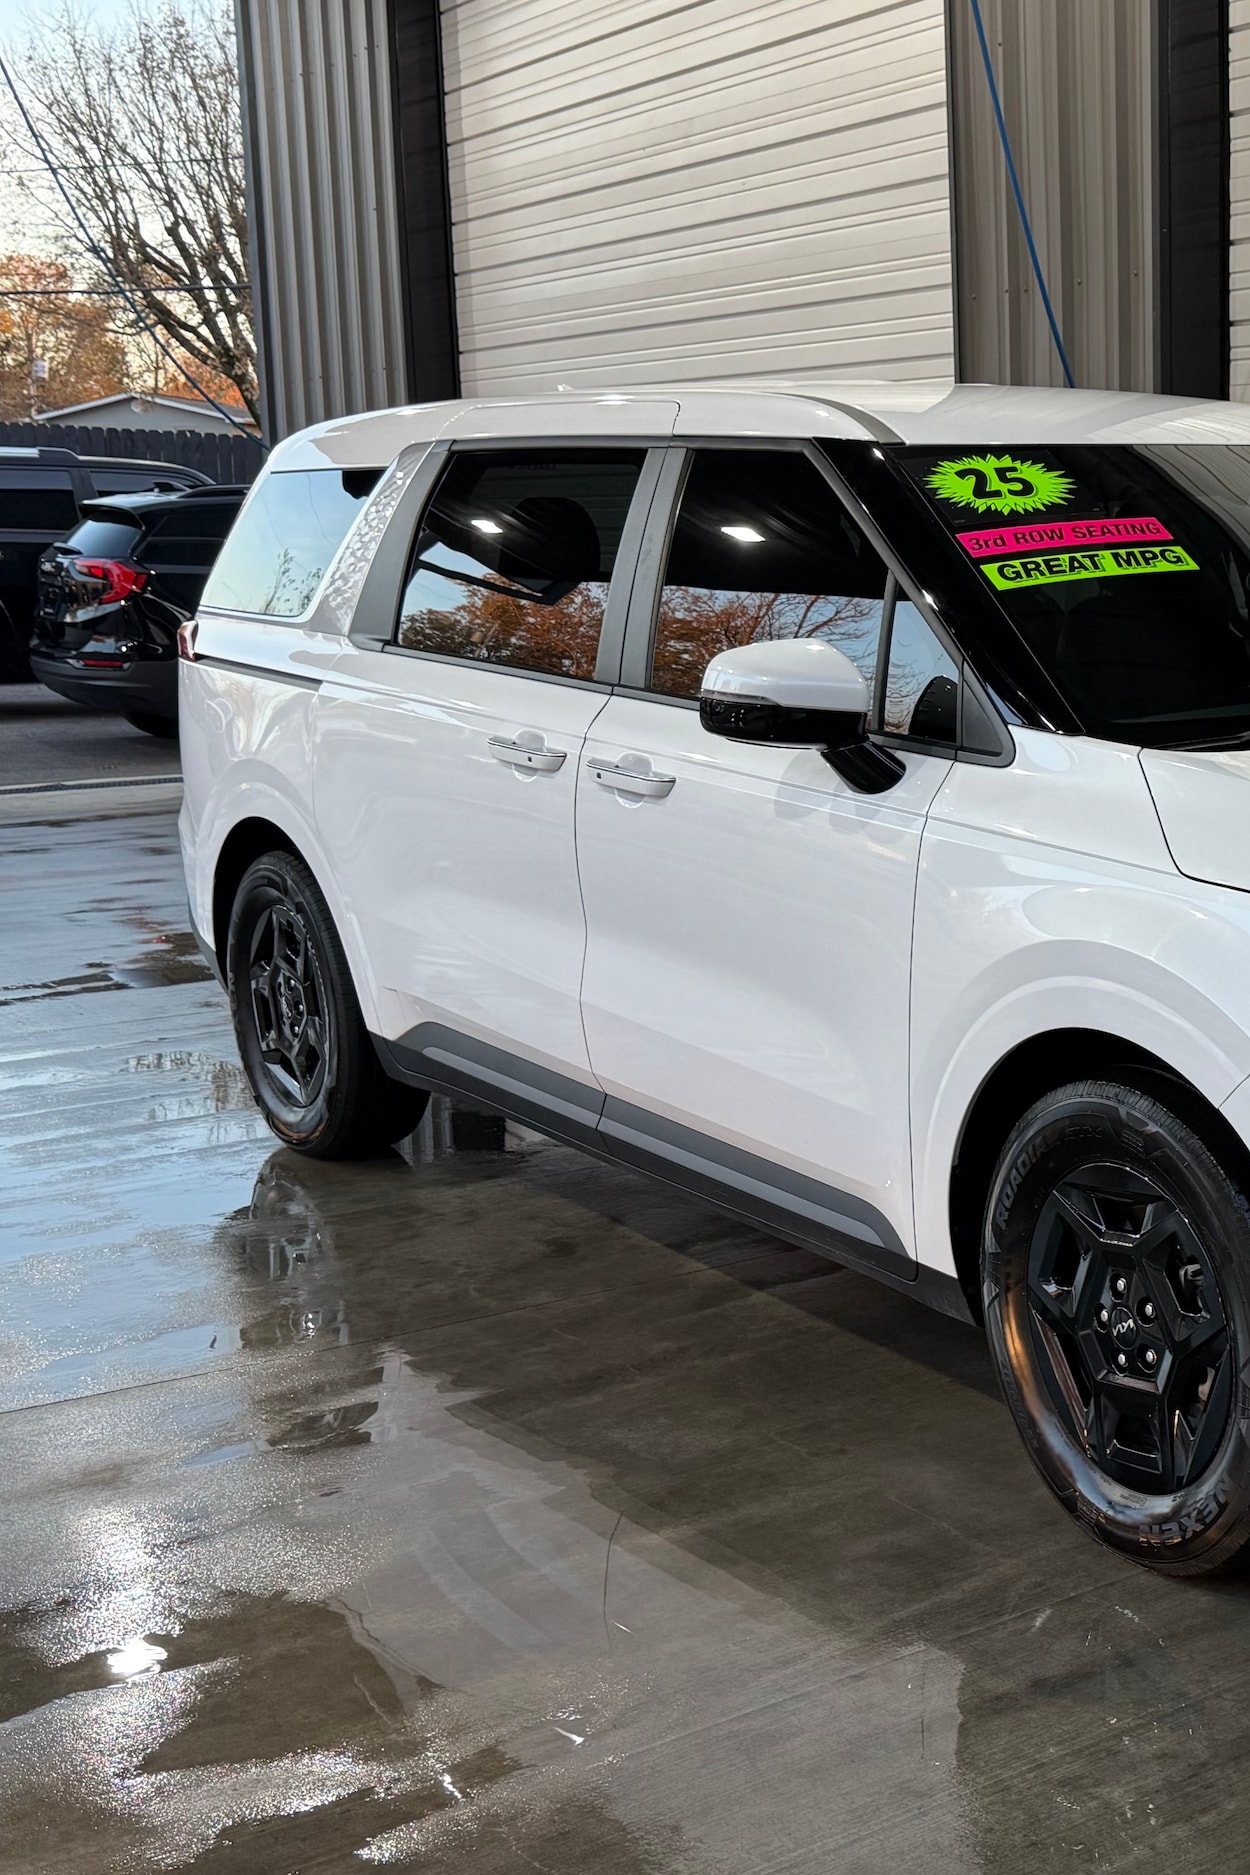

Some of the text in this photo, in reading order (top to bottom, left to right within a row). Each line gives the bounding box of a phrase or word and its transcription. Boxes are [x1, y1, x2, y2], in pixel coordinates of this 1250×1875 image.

[954, 466, 1037, 501] 25
[968, 522, 1163, 552] 3rd ROW SEATING
[996, 548, 1187, 582] GREAT MPG
[1137, 1470, 1234, 1547] NEXEN
